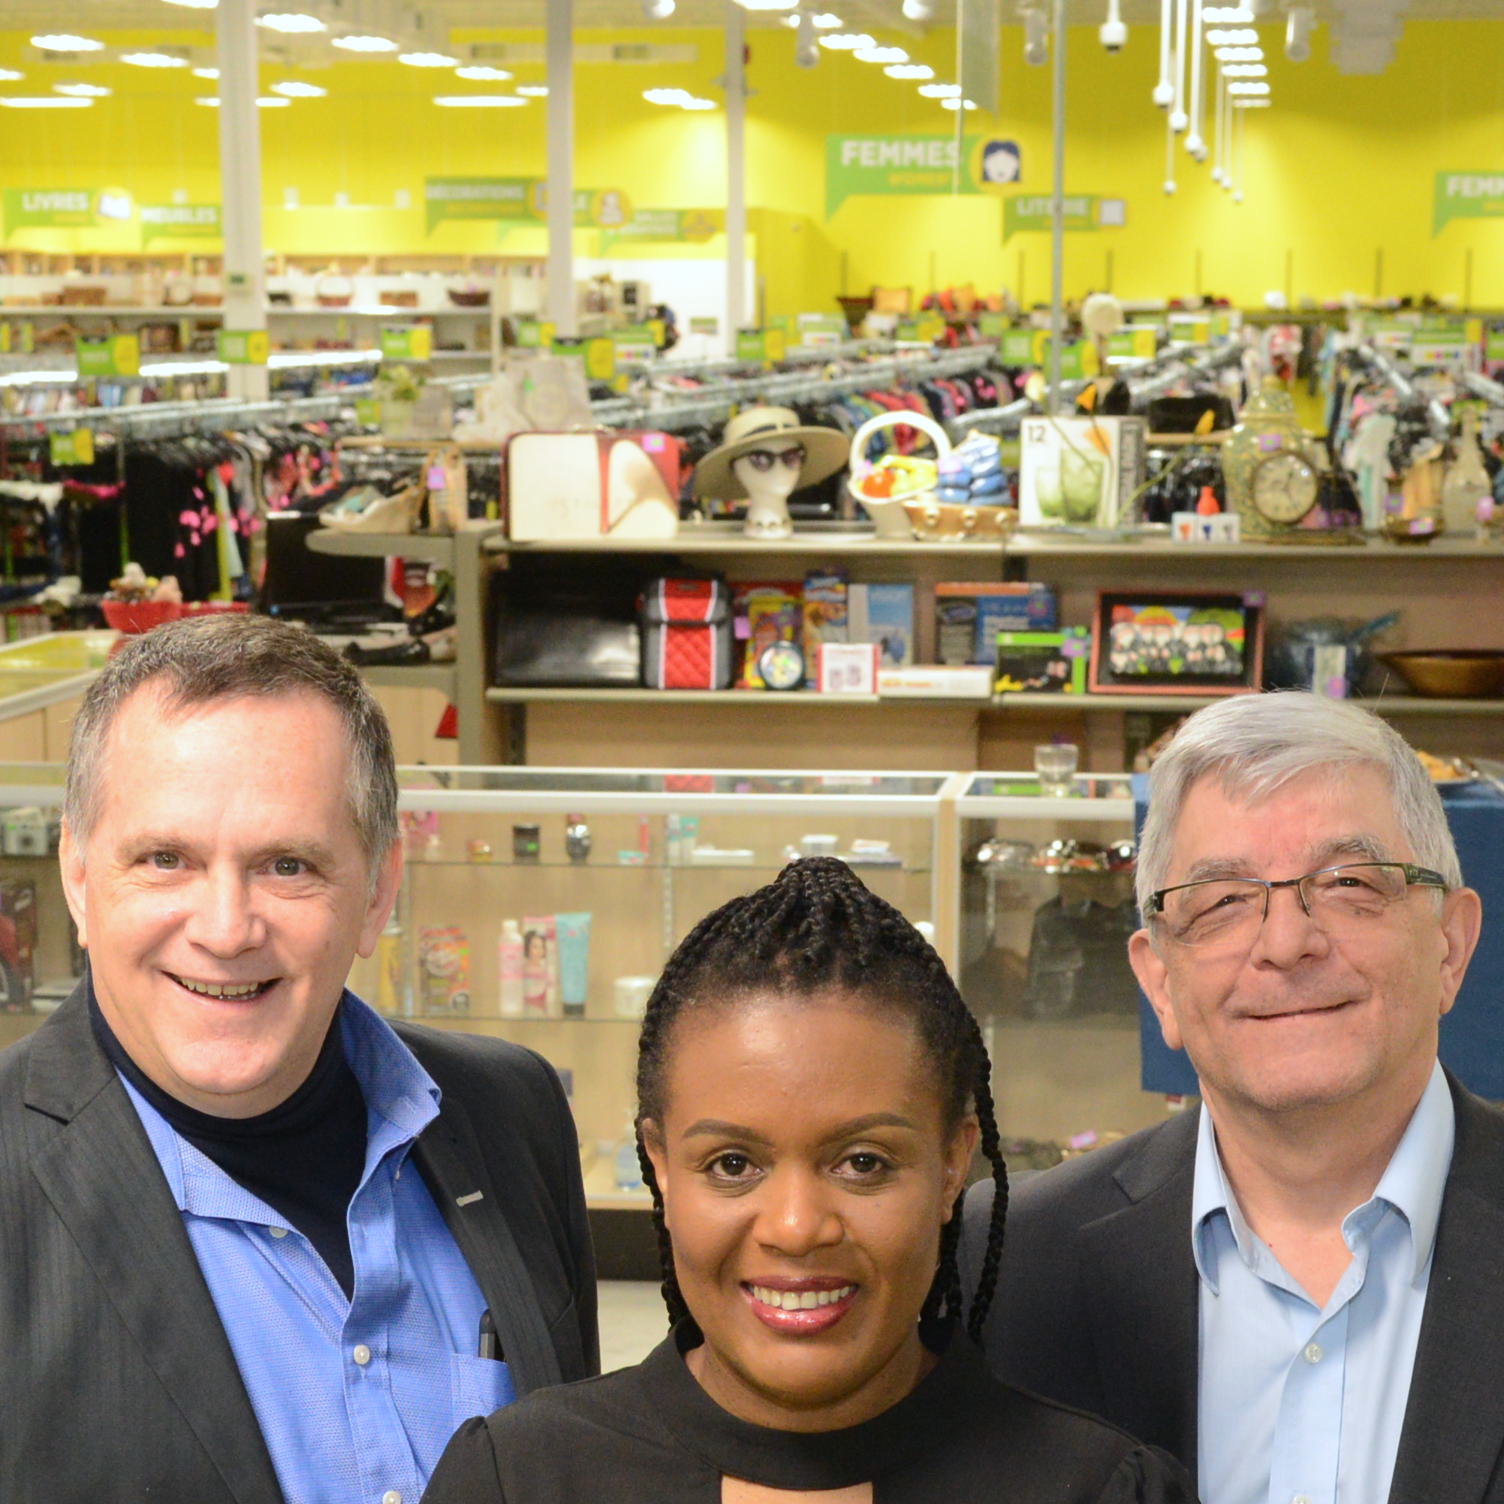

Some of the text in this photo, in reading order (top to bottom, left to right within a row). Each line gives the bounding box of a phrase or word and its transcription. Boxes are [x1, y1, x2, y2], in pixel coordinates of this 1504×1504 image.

[841, 140, 961, 168] FEMMES
[22, 191, 89, 212] LIVRES
[1027, 425, 1046, 443] 12
